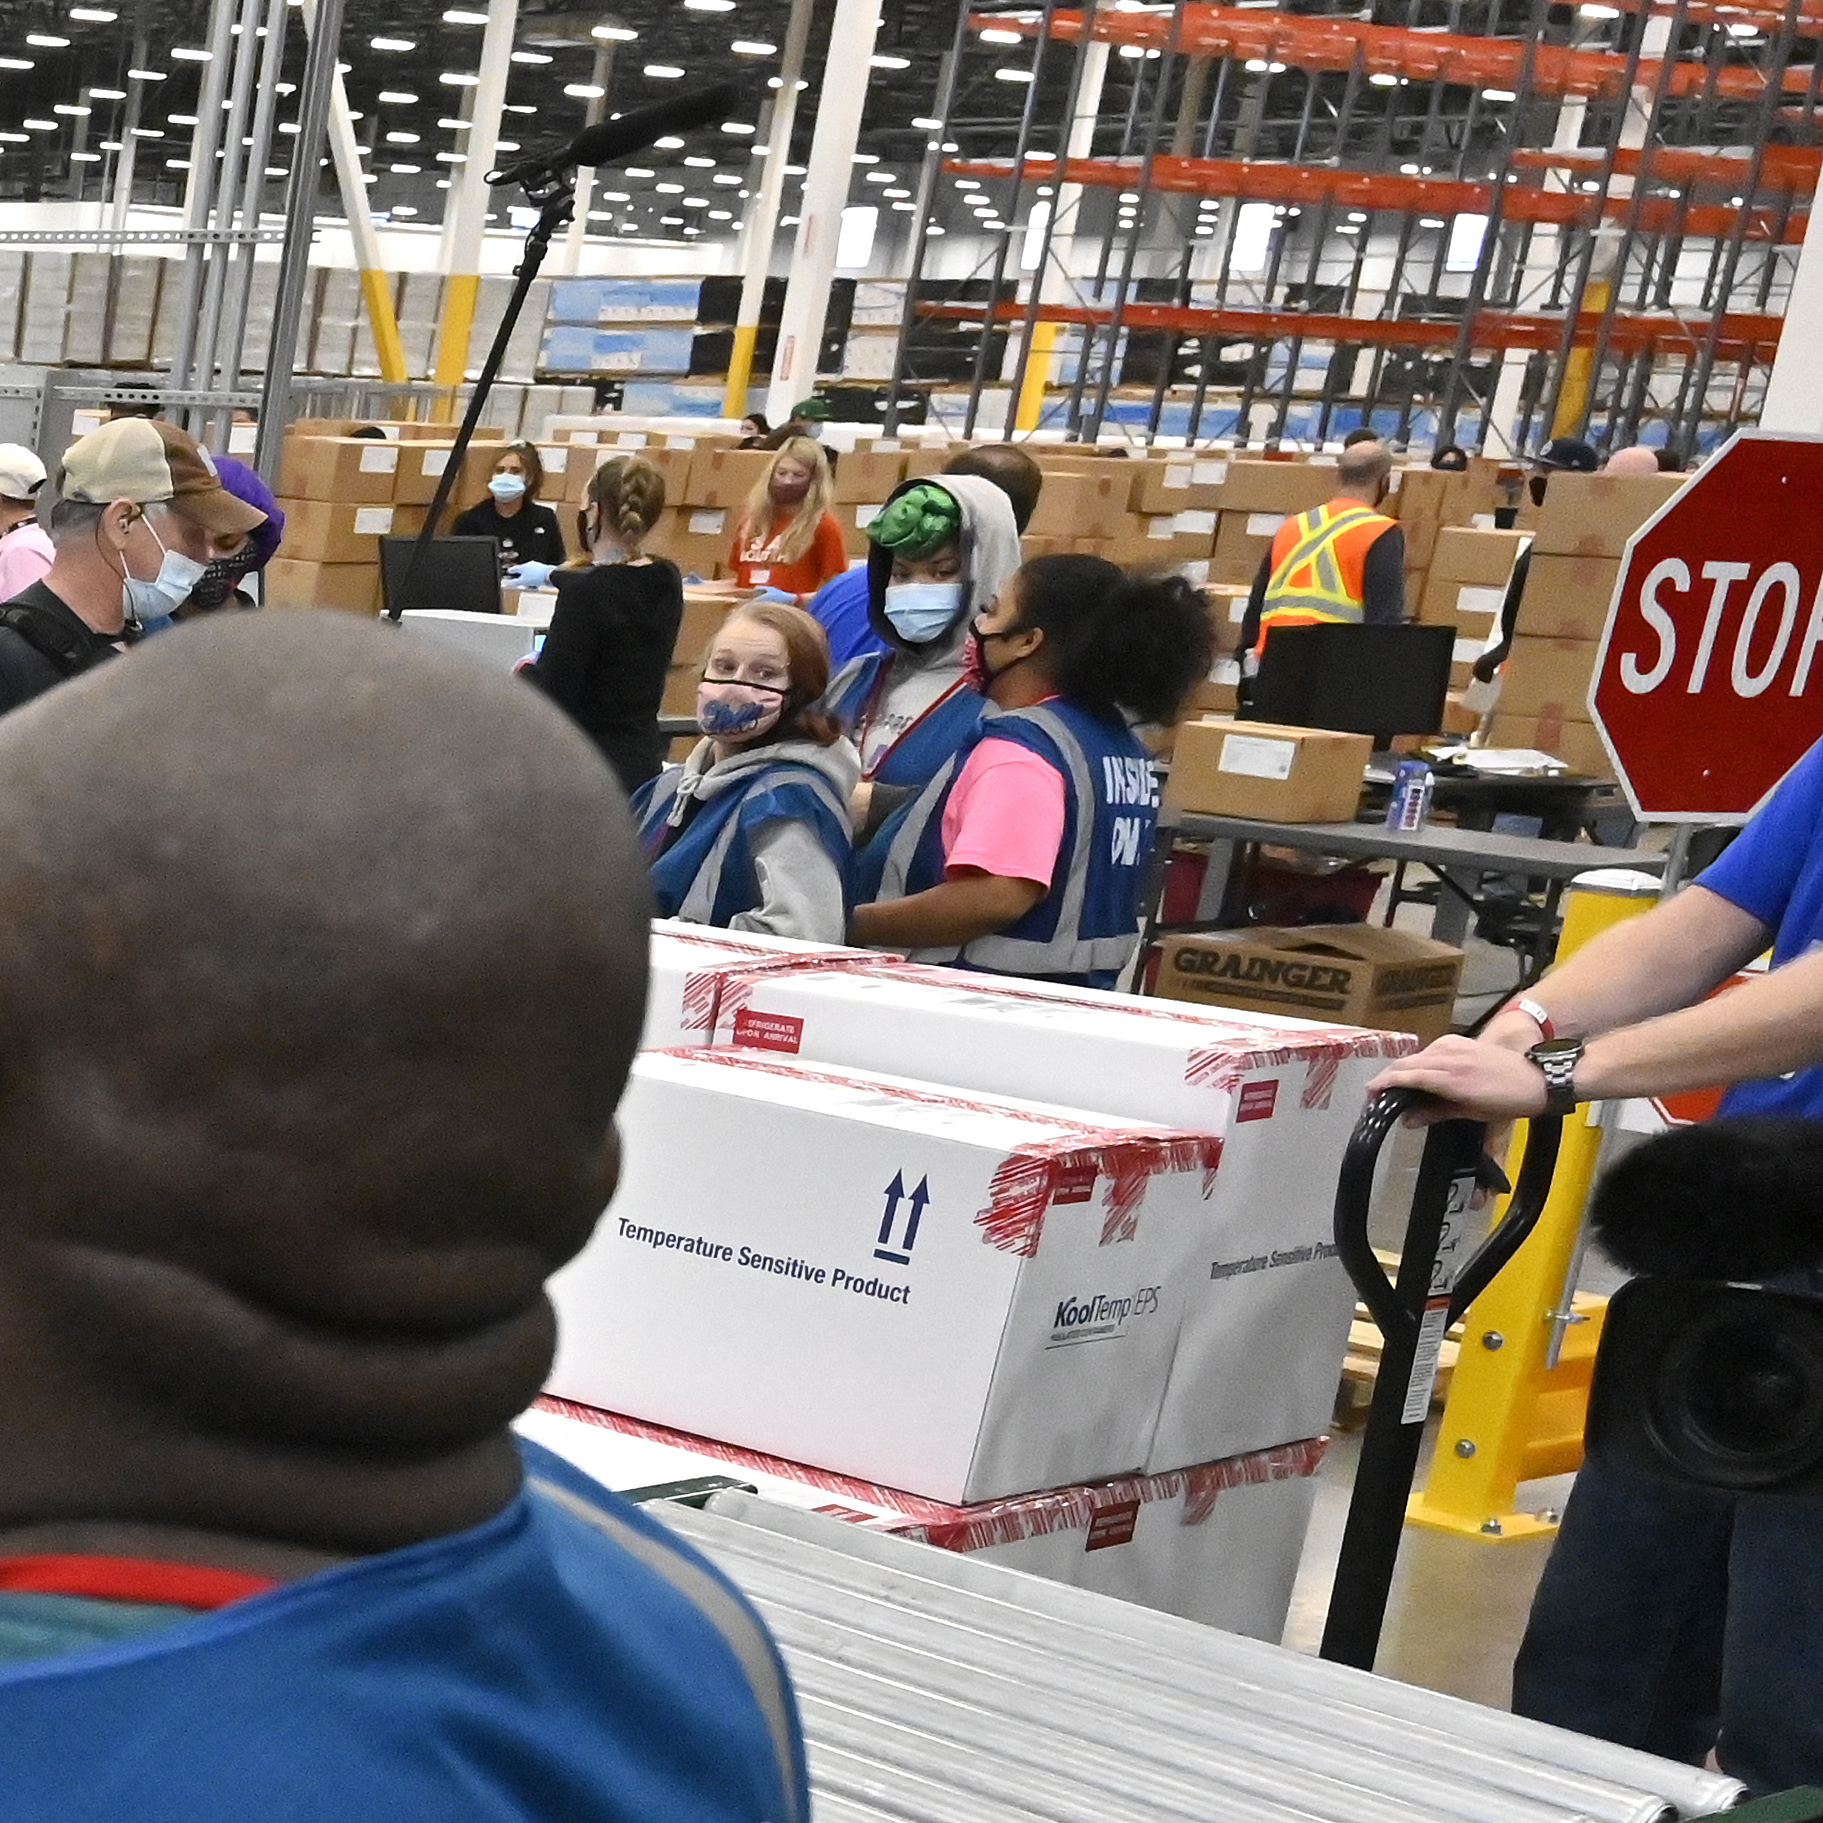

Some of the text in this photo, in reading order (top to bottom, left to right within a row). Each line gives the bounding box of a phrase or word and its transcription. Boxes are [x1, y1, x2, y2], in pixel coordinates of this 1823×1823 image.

[1174, 947, 1352, 995] GRAINGER
[618, 1217, 911, 1304] Temperature Sensitive Product
[1054, 1286, 1162, 1328] KoolTemp EPS
